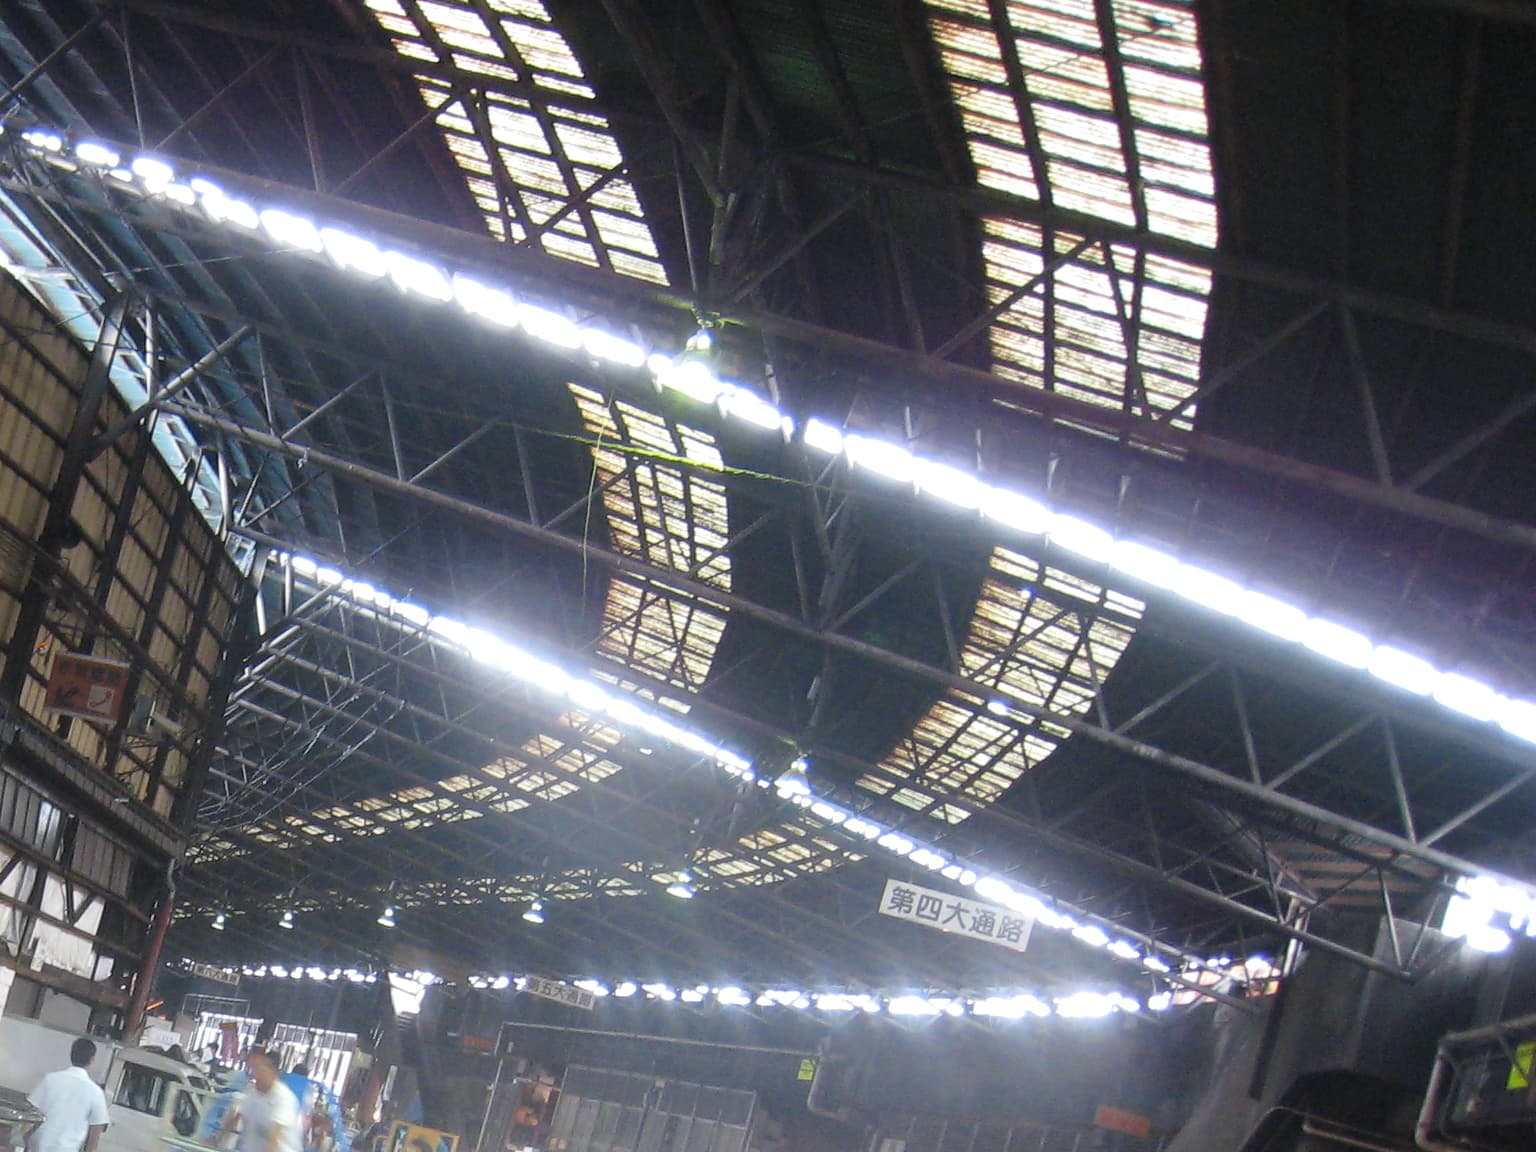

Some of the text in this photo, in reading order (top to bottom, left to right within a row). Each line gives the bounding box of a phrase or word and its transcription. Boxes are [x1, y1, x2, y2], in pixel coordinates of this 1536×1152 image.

[888, 886, 1026, 943] 第四大通路
